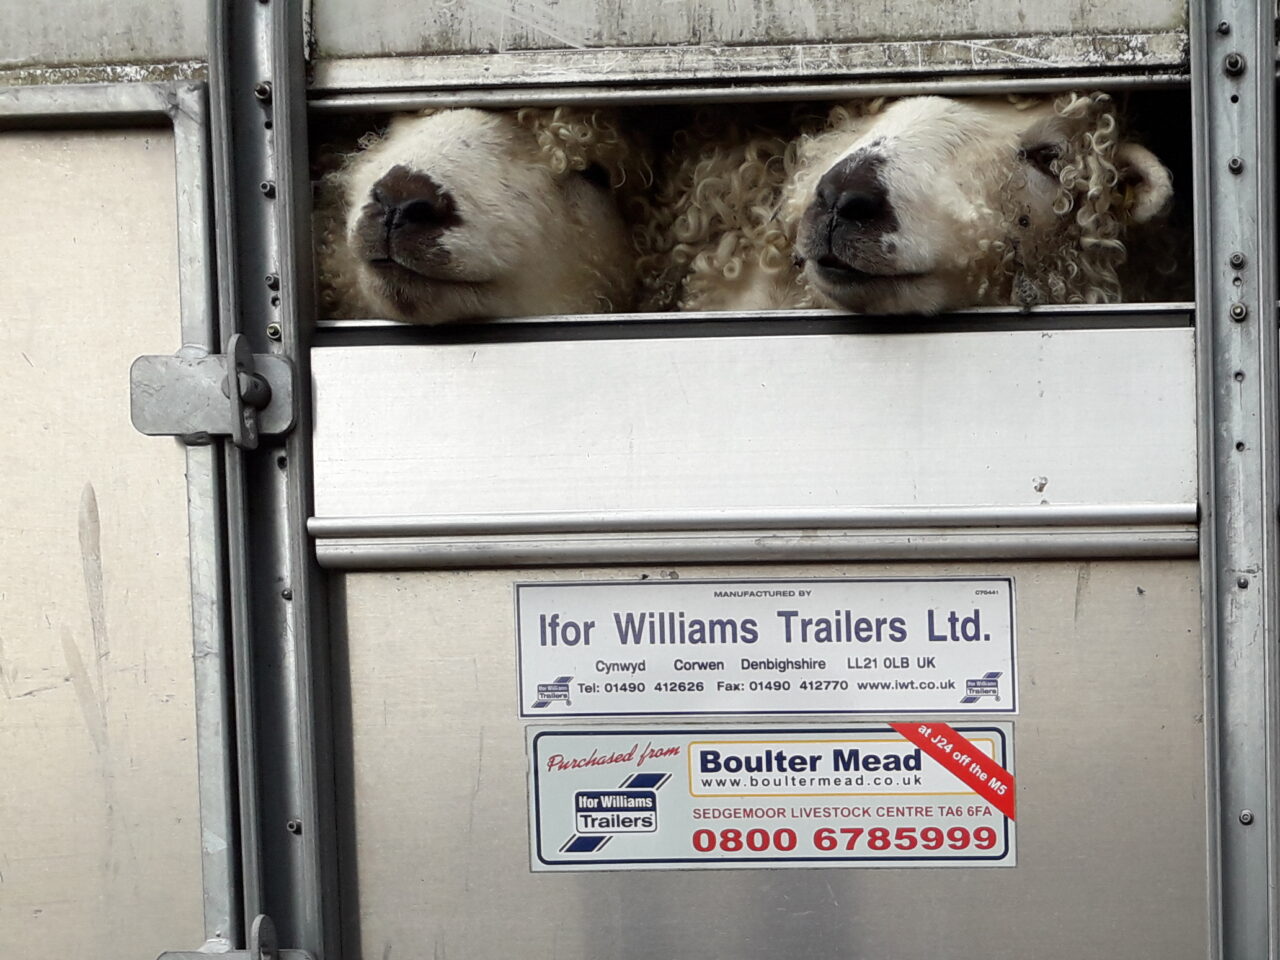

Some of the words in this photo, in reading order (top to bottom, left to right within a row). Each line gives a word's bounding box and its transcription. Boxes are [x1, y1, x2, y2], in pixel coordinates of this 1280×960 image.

[714, 590, 796, 598] MANUFACTURED
[540, 613, 595, 646] Ifor
[614, 612, 759, 645] Williams
[777, 609, 907, 643] Trailers
[928, 609, 990, 642] Ltd.
[596, 660, 646, 674] Cynwyd
[674, 659, 724, 671] Corwen
[741, 657, 826, 672] Denbighshire
[847, 657, 878, 669] LL21
[917, 656, 936, 669] UK
[577, 682, 600, 693] Tel:
[604, 682, 646, 693] 01490
[654, 681, 704, 692] 412626
[717, 680, 745, 692] Fax:
[749, 679, 791, 691] 01490
[799, 679, 849, 691] 412770
[857, 678, 956, 690] www.iwt.co.uk
[547, 743, 639, 772] Purchased
[636, 741, 681, 767] from
[699, 750, 823, 773] Boulter
[832, 748, 922, 772] Mead
[917, 724, 933, 738] at
[930, 734, 954, 753] J24
[952, 751, 973, 767] off
[968, 762, 989, 782] the
[987, 777, 1009, 796] M5
[701, 774, 922, 787] www.boultermead.co.uk
[578, 796, 599, 808] Ifor
[600, 795, 653, 808] Williams
[692, 807, 786, 820] SEDGEMOOR
[791, 806, 872, 818] LIVESTOCK
[876, 805, 933, 818] CENTRE
[937, 805, 963, 817] TA6
[967, 805, 993, 817] 6FA
[579, 814, 653, 828] Trailers
[692, 827, 797, 853] 0800
[813, 826, 997, 851] 6785999
